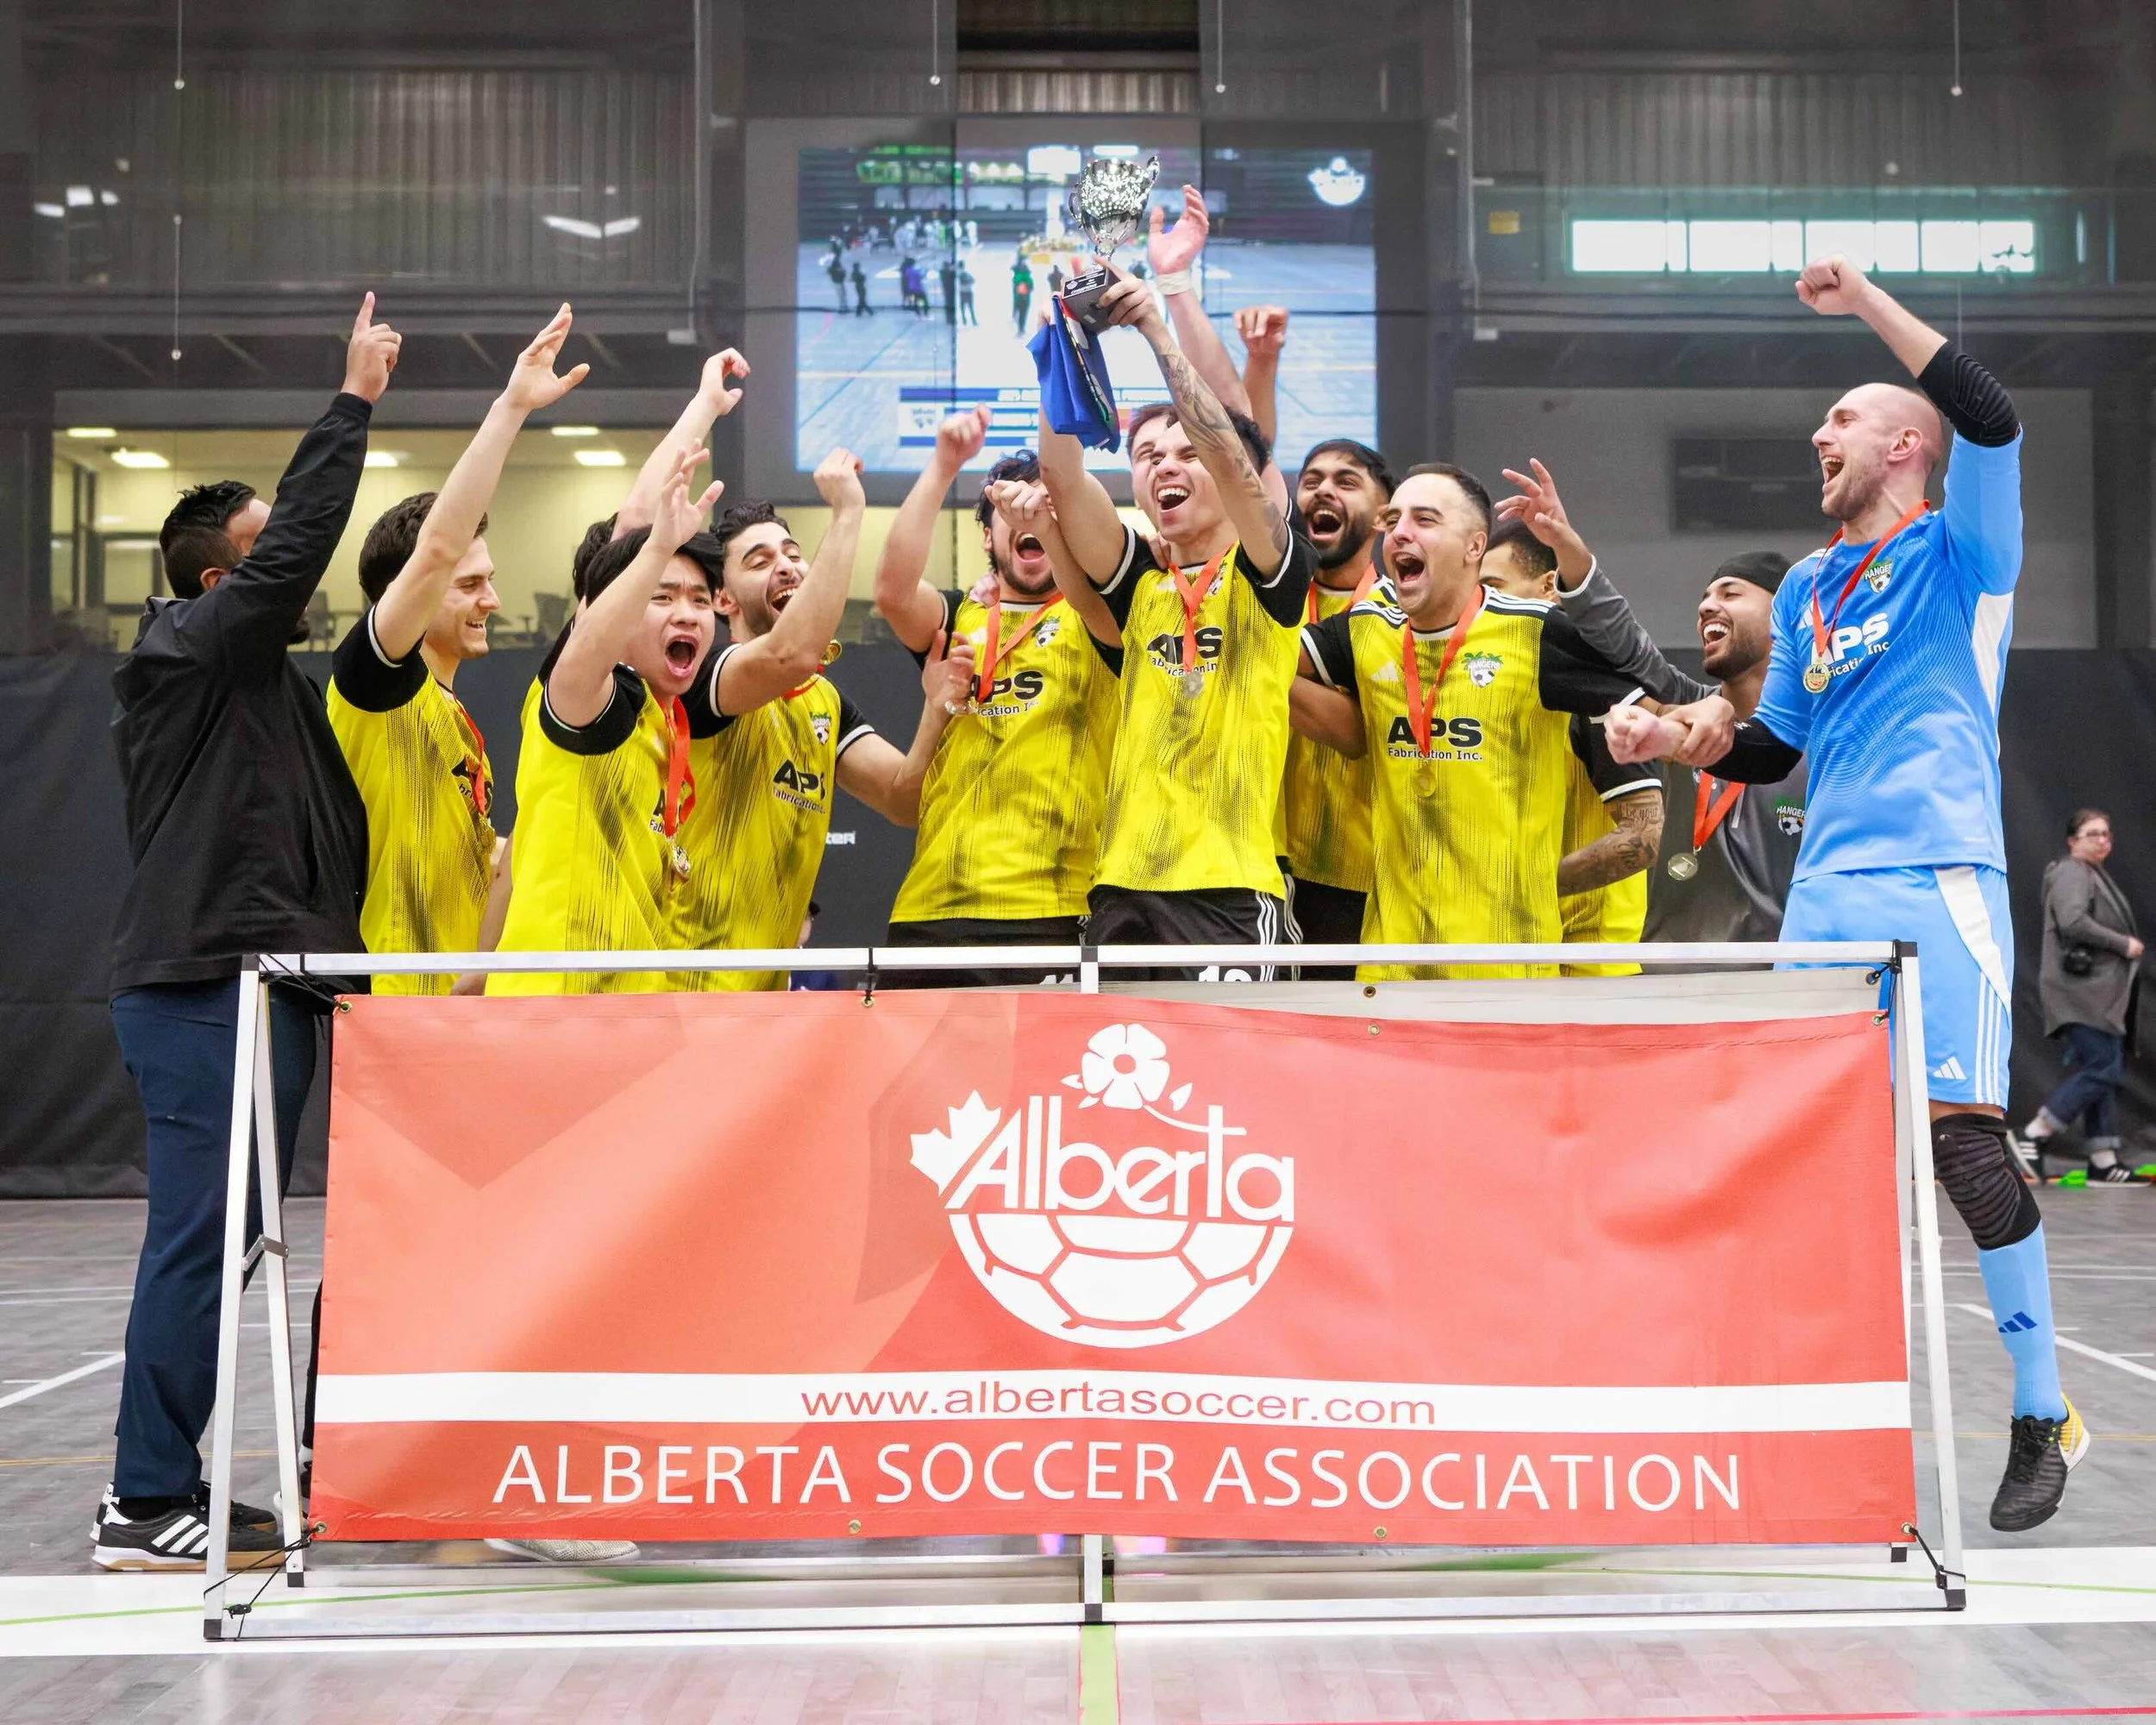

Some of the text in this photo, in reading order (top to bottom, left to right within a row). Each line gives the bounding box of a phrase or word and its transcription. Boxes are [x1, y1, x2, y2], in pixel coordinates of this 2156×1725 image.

[1865, 563, 1892, 580] RANGE
[1457, 750, 1482, 760] Inc.
[1777, 806, 1806, 819] RANGER
[944, 1095, 1294, 1222] Alberta
[800, 1381, 1435, 1425] www.albertasoccer.com
[492, 1440, 1739, 1511] ALBERTA SOCCER ASSOCIATION
